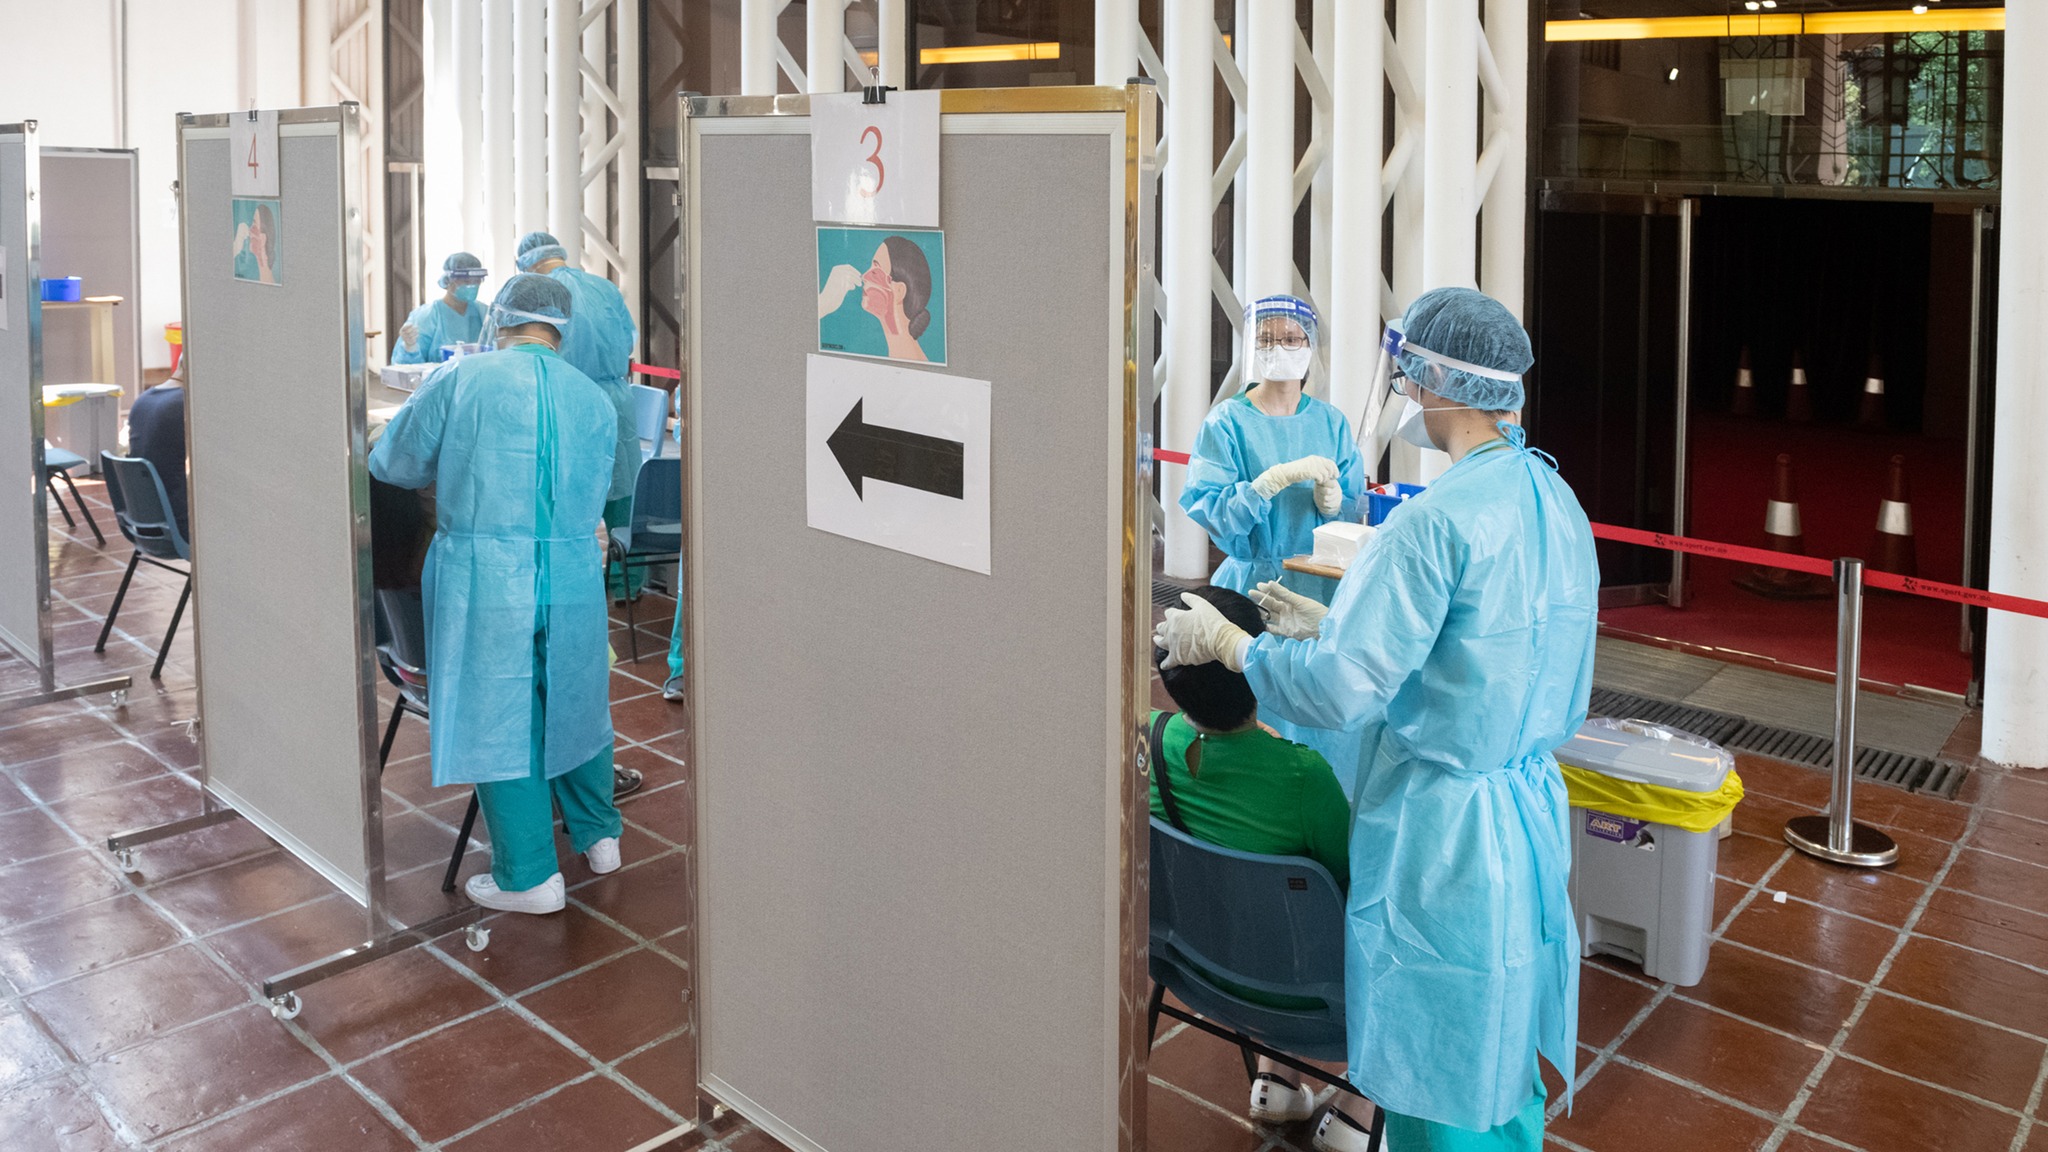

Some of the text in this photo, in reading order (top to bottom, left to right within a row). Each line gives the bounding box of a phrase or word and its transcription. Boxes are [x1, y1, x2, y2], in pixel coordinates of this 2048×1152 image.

[248, 133, 259, 179] 4
[860, 126, 884, 198] 3
[1920, 585, 1992, 601] www.sport.gov.mo
[1590, 818, 1622, 833] ART
